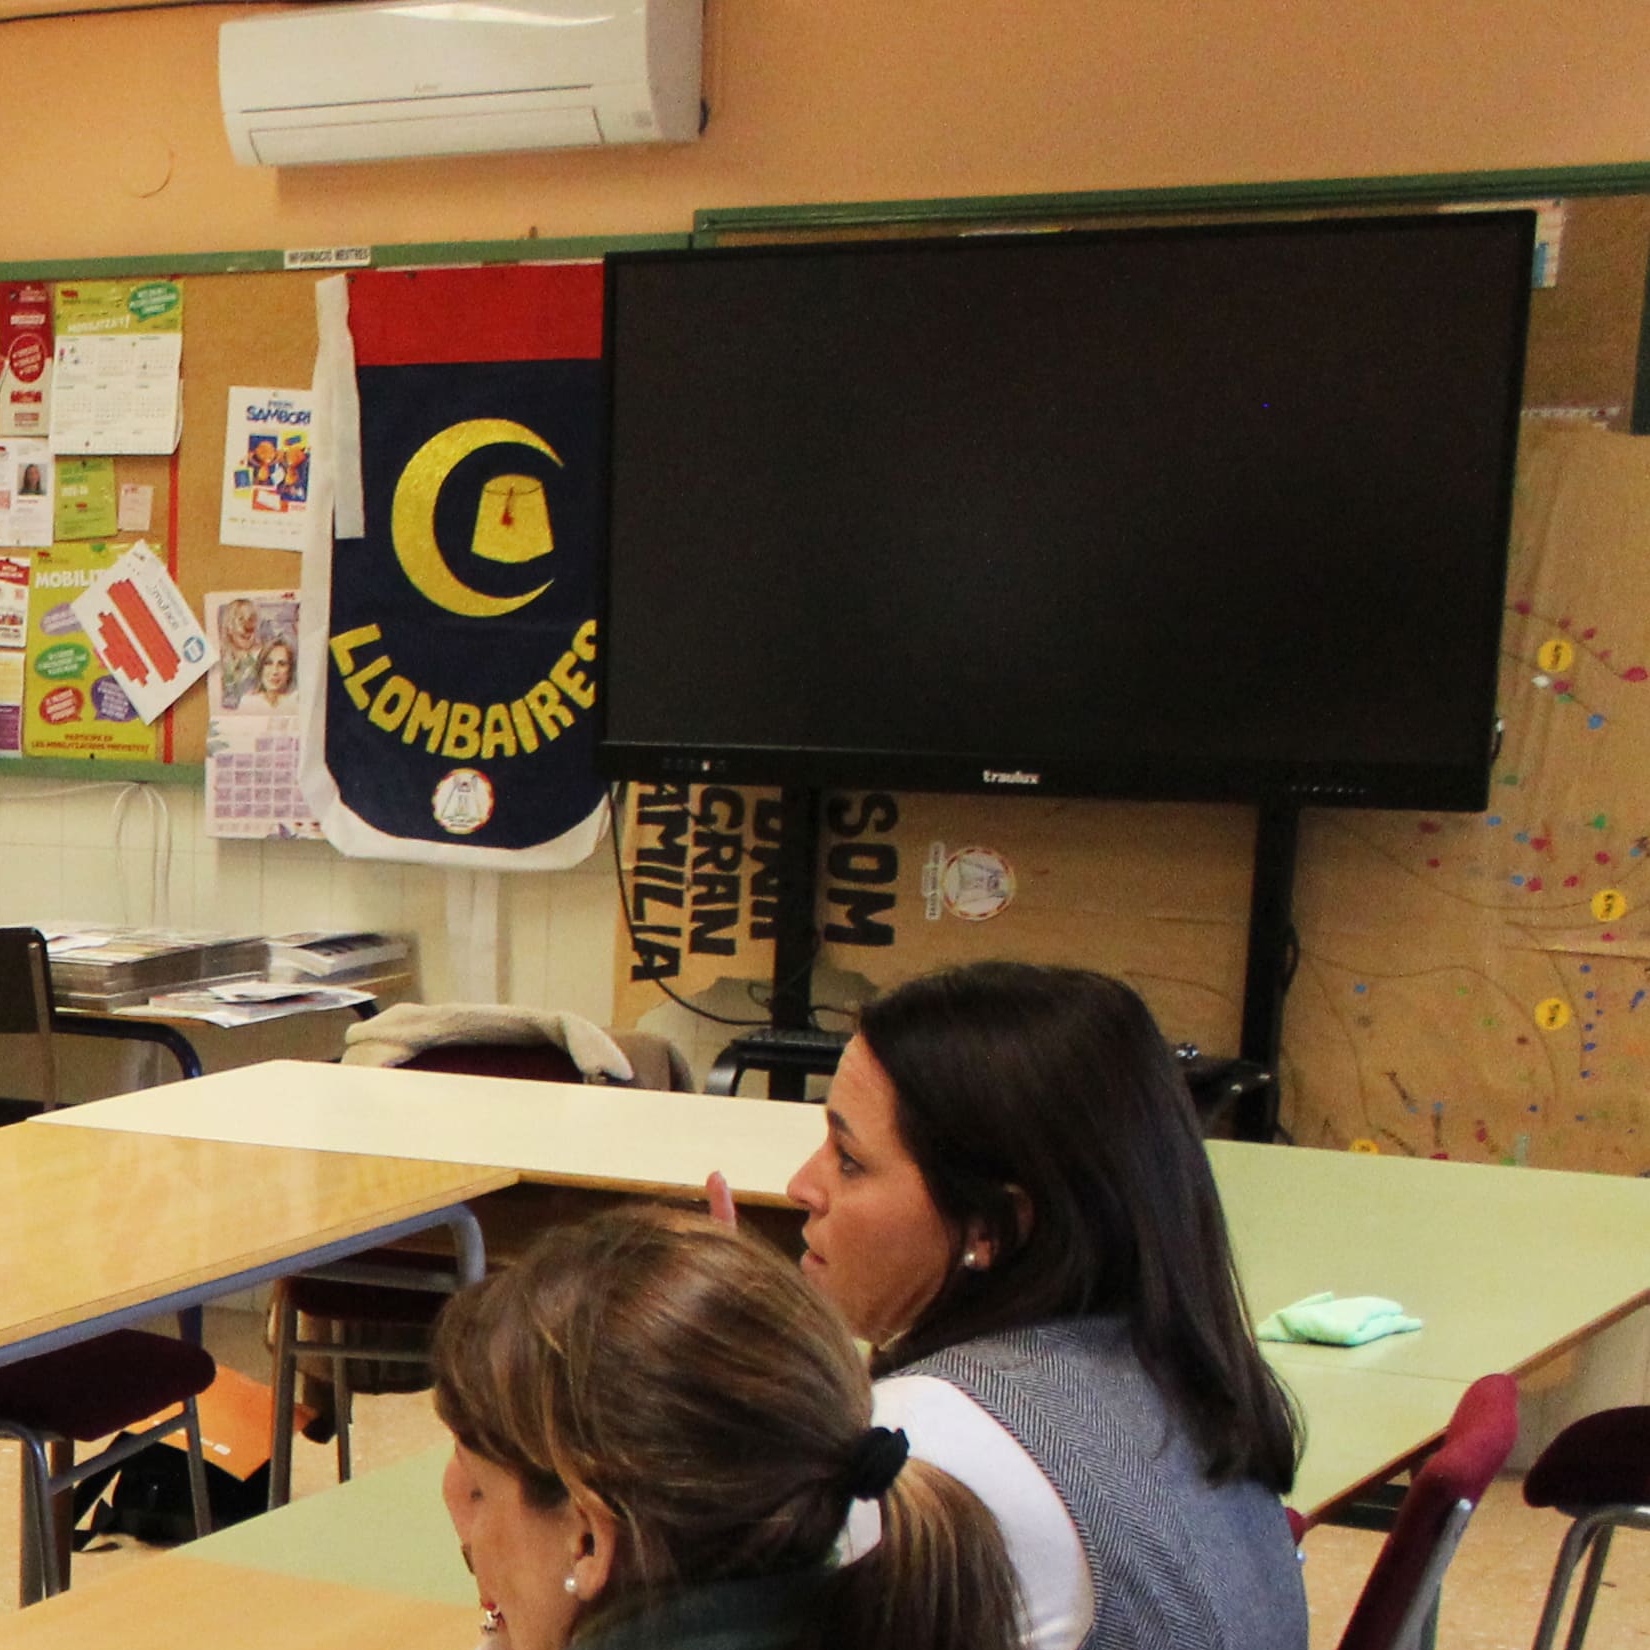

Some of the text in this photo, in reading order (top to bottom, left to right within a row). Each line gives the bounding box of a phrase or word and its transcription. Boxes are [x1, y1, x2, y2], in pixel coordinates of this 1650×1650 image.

[630, 783, 690, 983] AMILIA
[689, 786, 745, 957] GRAN
[825, 793, 899, 947] SOM
